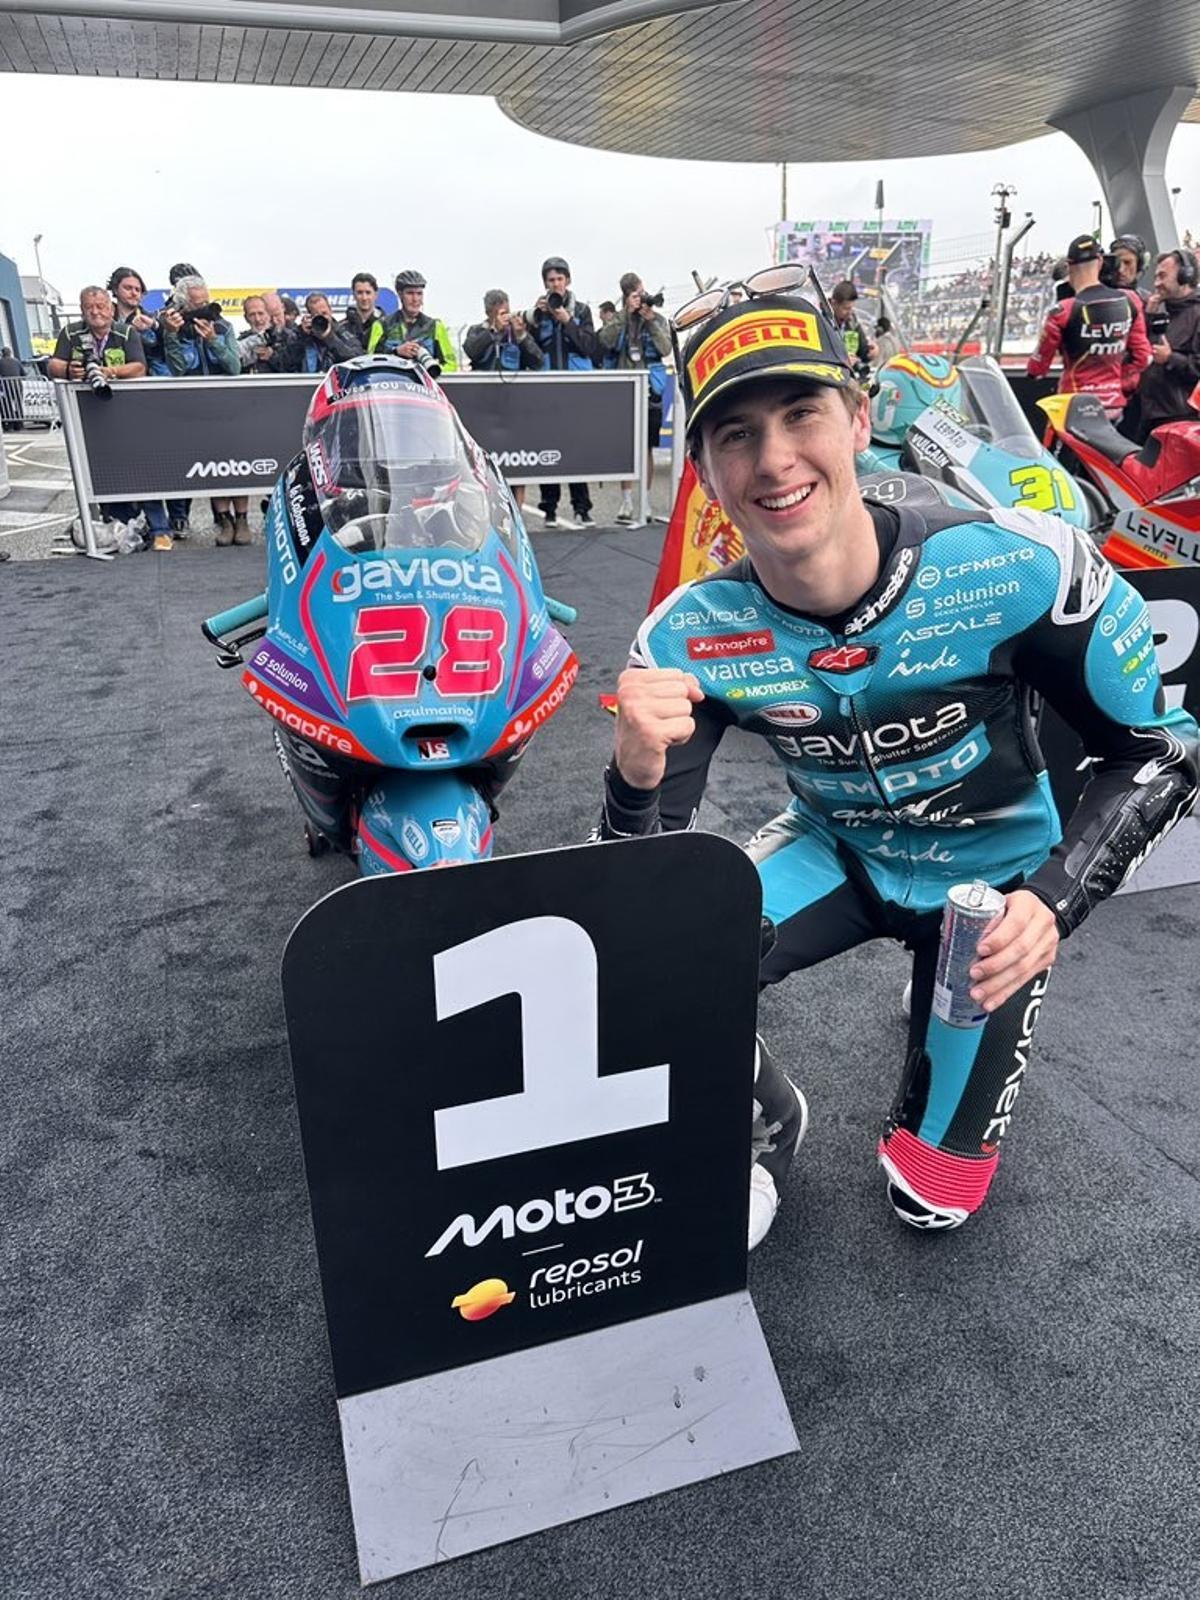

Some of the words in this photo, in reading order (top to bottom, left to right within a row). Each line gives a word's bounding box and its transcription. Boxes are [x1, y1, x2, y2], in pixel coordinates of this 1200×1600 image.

[695, 317, 809, 385] PIRELLI
[370, 381, 399, 390] YOU
[912, 433, 949, 467] VULCAIN
[186, 459, 278, 478] MotoGP
[1009, 464, 1076, 512] 31
[331, 558, 503, 602] gaviota
[945, 548, 1035, 579] CFMOTO
[845, 548, 913, 635] alpinestars
[934, 580, 1020, 610] solunion
[669, 606, 758, 631] gaviota
[896, 612, 1003, 645] ASCALE
[347, 604, 508, 702] 28
[714, 636, 768, 651] mapfre
[267, 658, 308, 692] solunion
[704, 656, 795, 682] valresa
[888, 646, 961, 678] inde
[745, 679, 809, 697] MOTOREX
[265, 697, 352, 754] mapfre
[393, 704, 474, 719] azulmarino
[764, 708, 811, 719] BELL
[776, 702, 968, 757] gaviota
[405, 825, 423, 854] BELL
[433, 915, 670, 1171] 1
[424, 1172, 656, 1258] Moto3
[529, 1239, 644, 1289] repsol
[530, 1270, 642, 1309] lubricants
